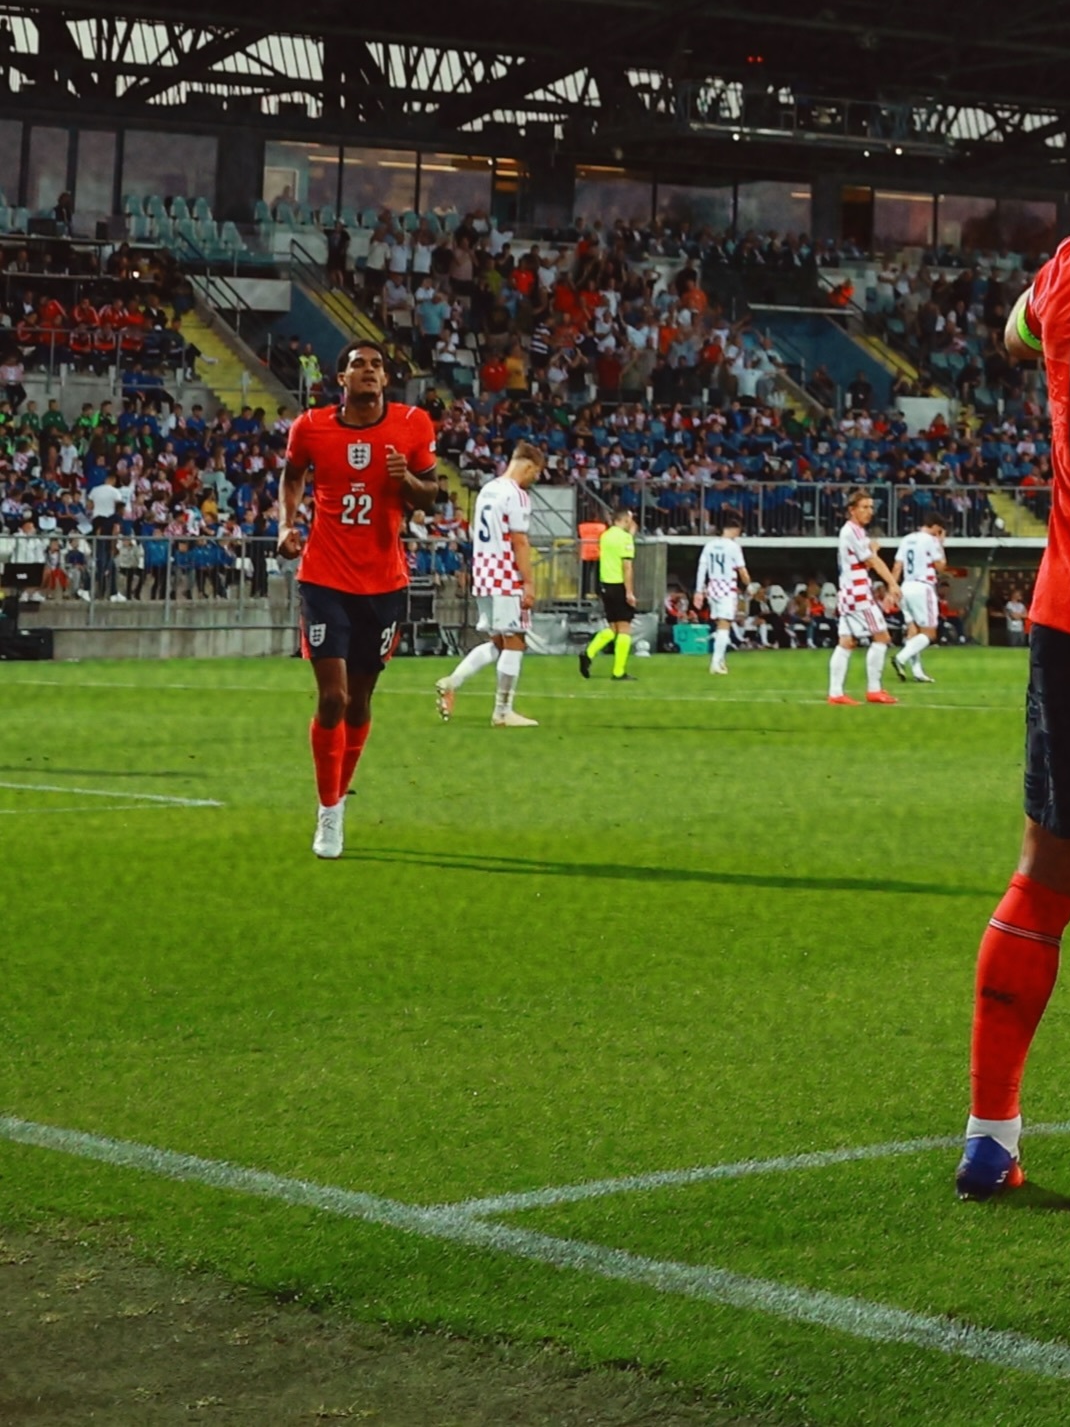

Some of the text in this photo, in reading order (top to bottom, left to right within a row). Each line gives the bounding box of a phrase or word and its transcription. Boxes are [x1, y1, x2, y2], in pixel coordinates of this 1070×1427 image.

[341, 494, 373, 526] 22
[710, 552, 726, 575] 14
[906, 549, 915, 575] 8
